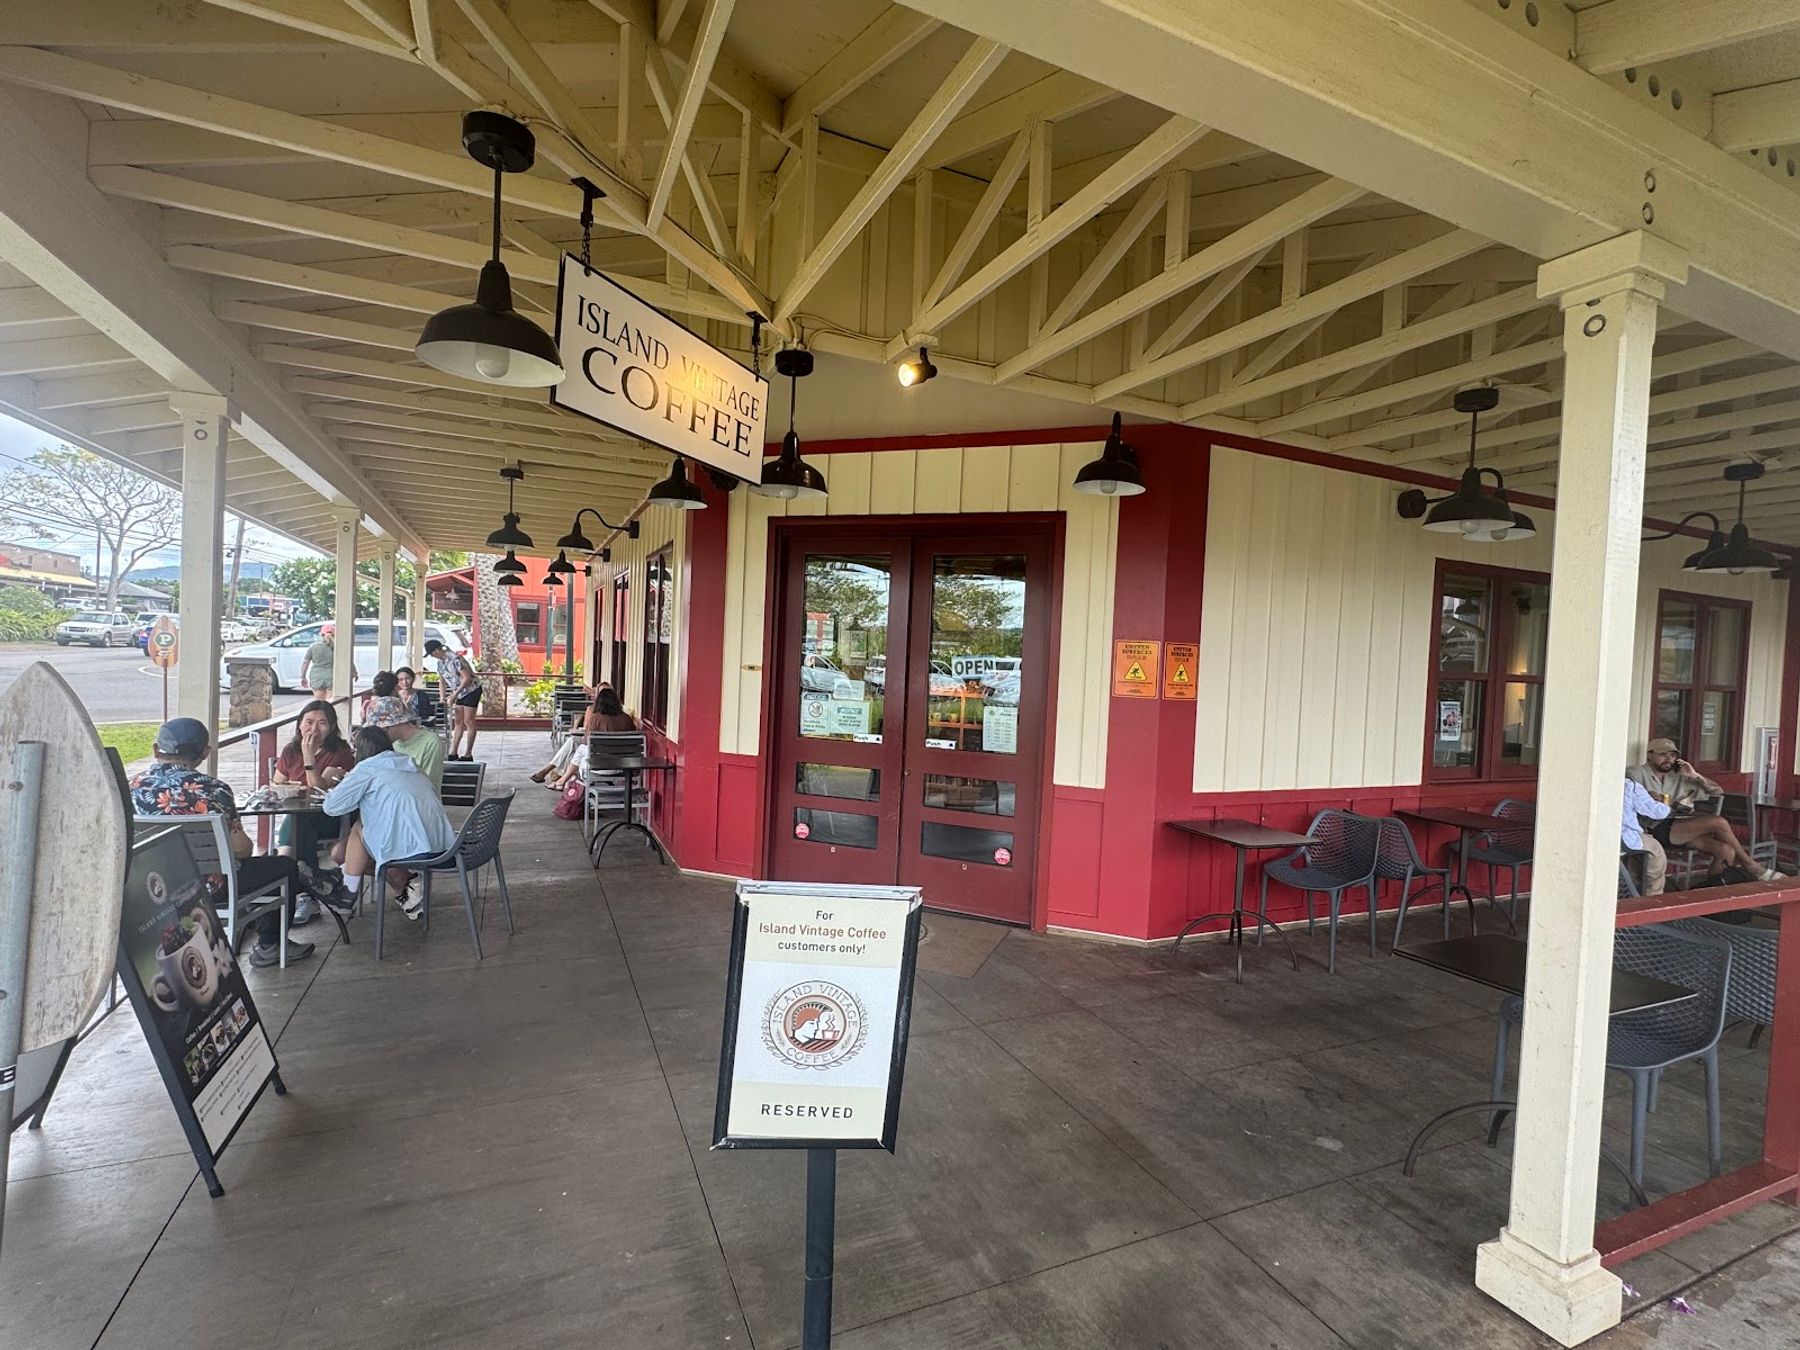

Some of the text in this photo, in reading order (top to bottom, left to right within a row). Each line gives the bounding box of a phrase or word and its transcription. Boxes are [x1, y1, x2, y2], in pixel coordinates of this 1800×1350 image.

[578, 294, 760, 422] ISLAND VINTAGE
[582, 346, 752, 457] COFFEE
[159, 634, 171, 645] P
[954, 660, 994, 675] OPEN
[815, 910, 834, 921] For
[759, 922, 887, 939] Island Vintage Coffee
[778, 941, 866, 955] customers only!
[773, 983, 858, 1028] ISLAND VINTAGE
[786, 1047, 839, 1064] COFFEE
[761, 1103, 854, 1119] RESERVED
